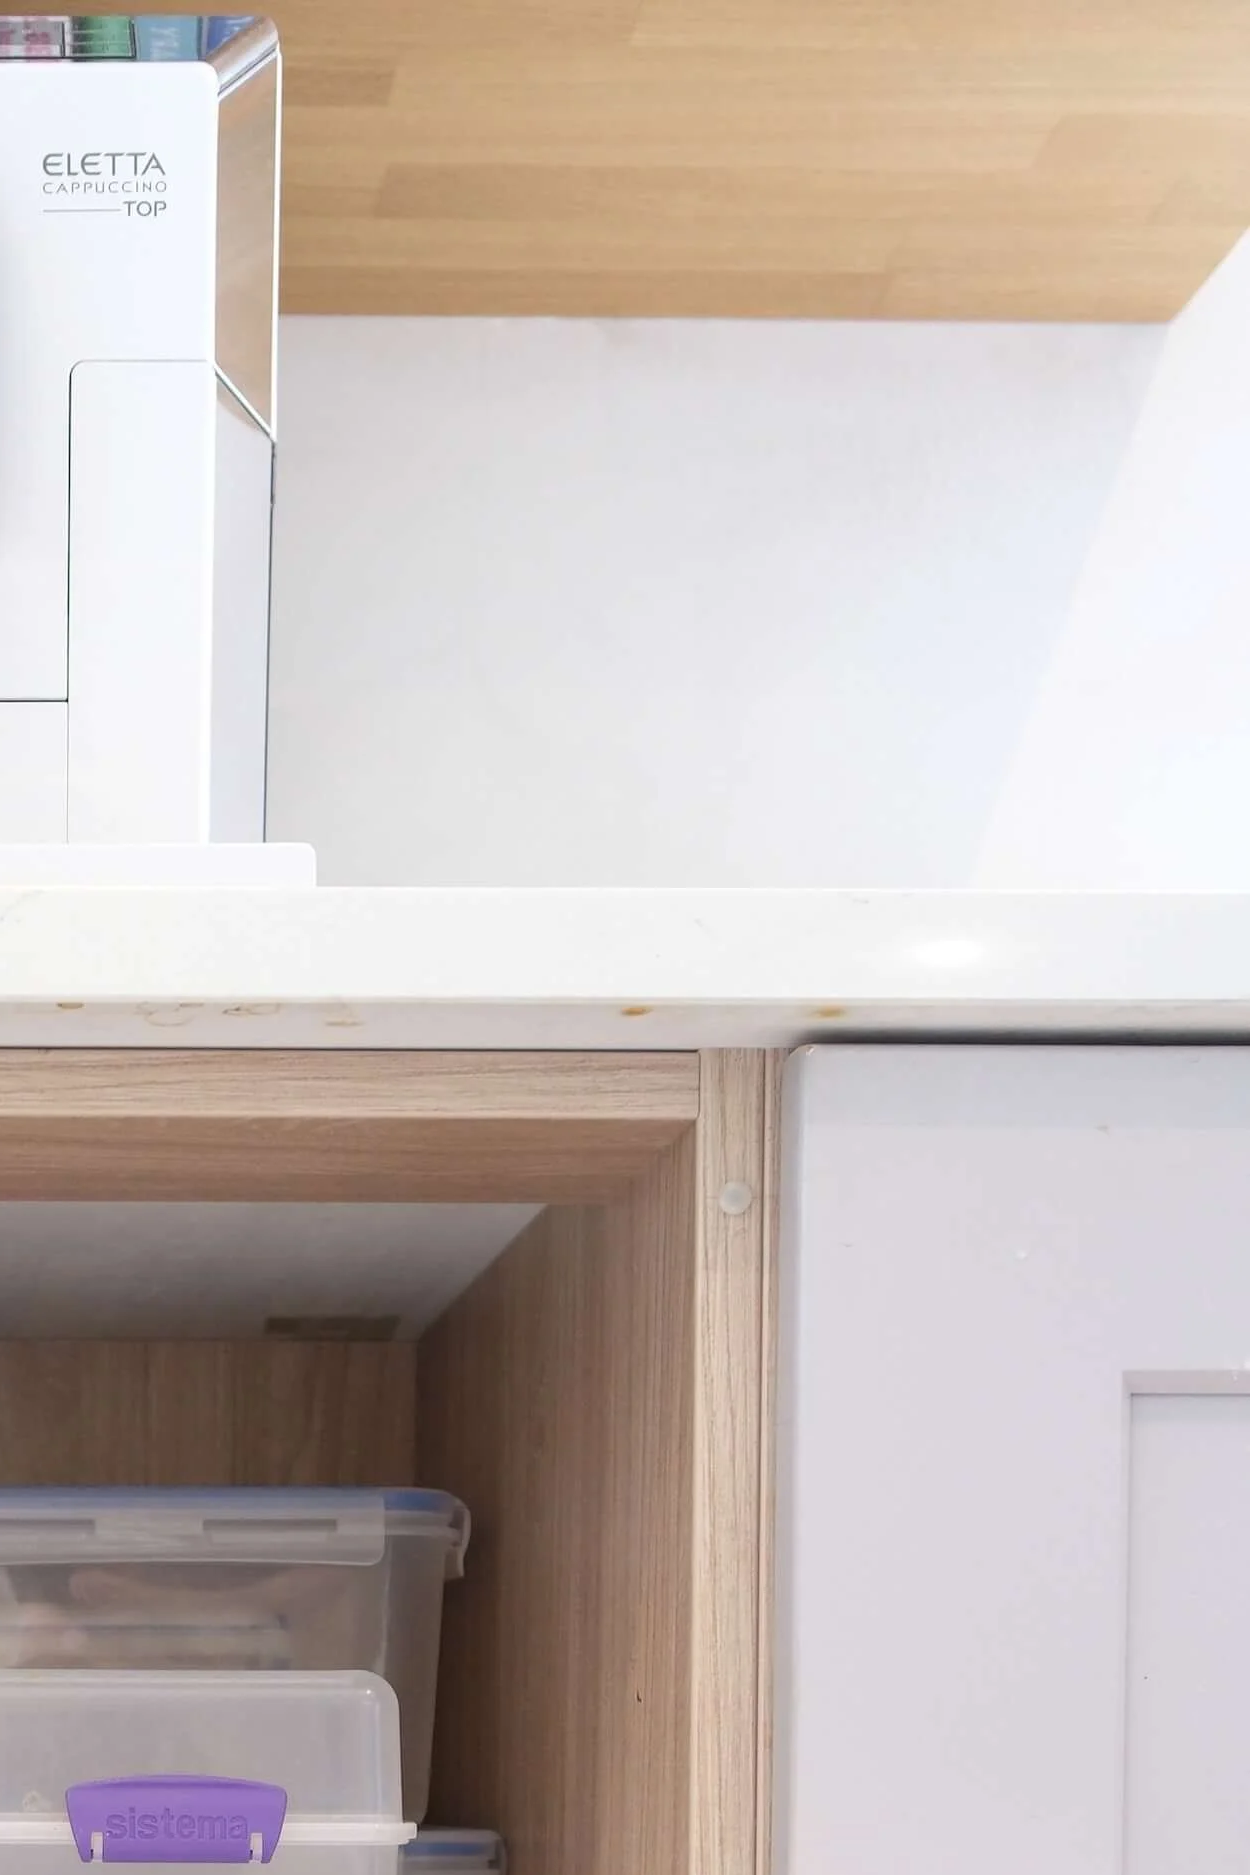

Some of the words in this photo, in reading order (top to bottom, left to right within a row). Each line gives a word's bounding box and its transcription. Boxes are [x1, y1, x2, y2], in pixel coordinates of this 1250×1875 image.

[42, 152, 166, 176] ELETTA
[42, 181, 167, 195] CAPPUCCINO
[123, 200, 167, 217] TOP
[106, 1807, 249, 1840] sistema
